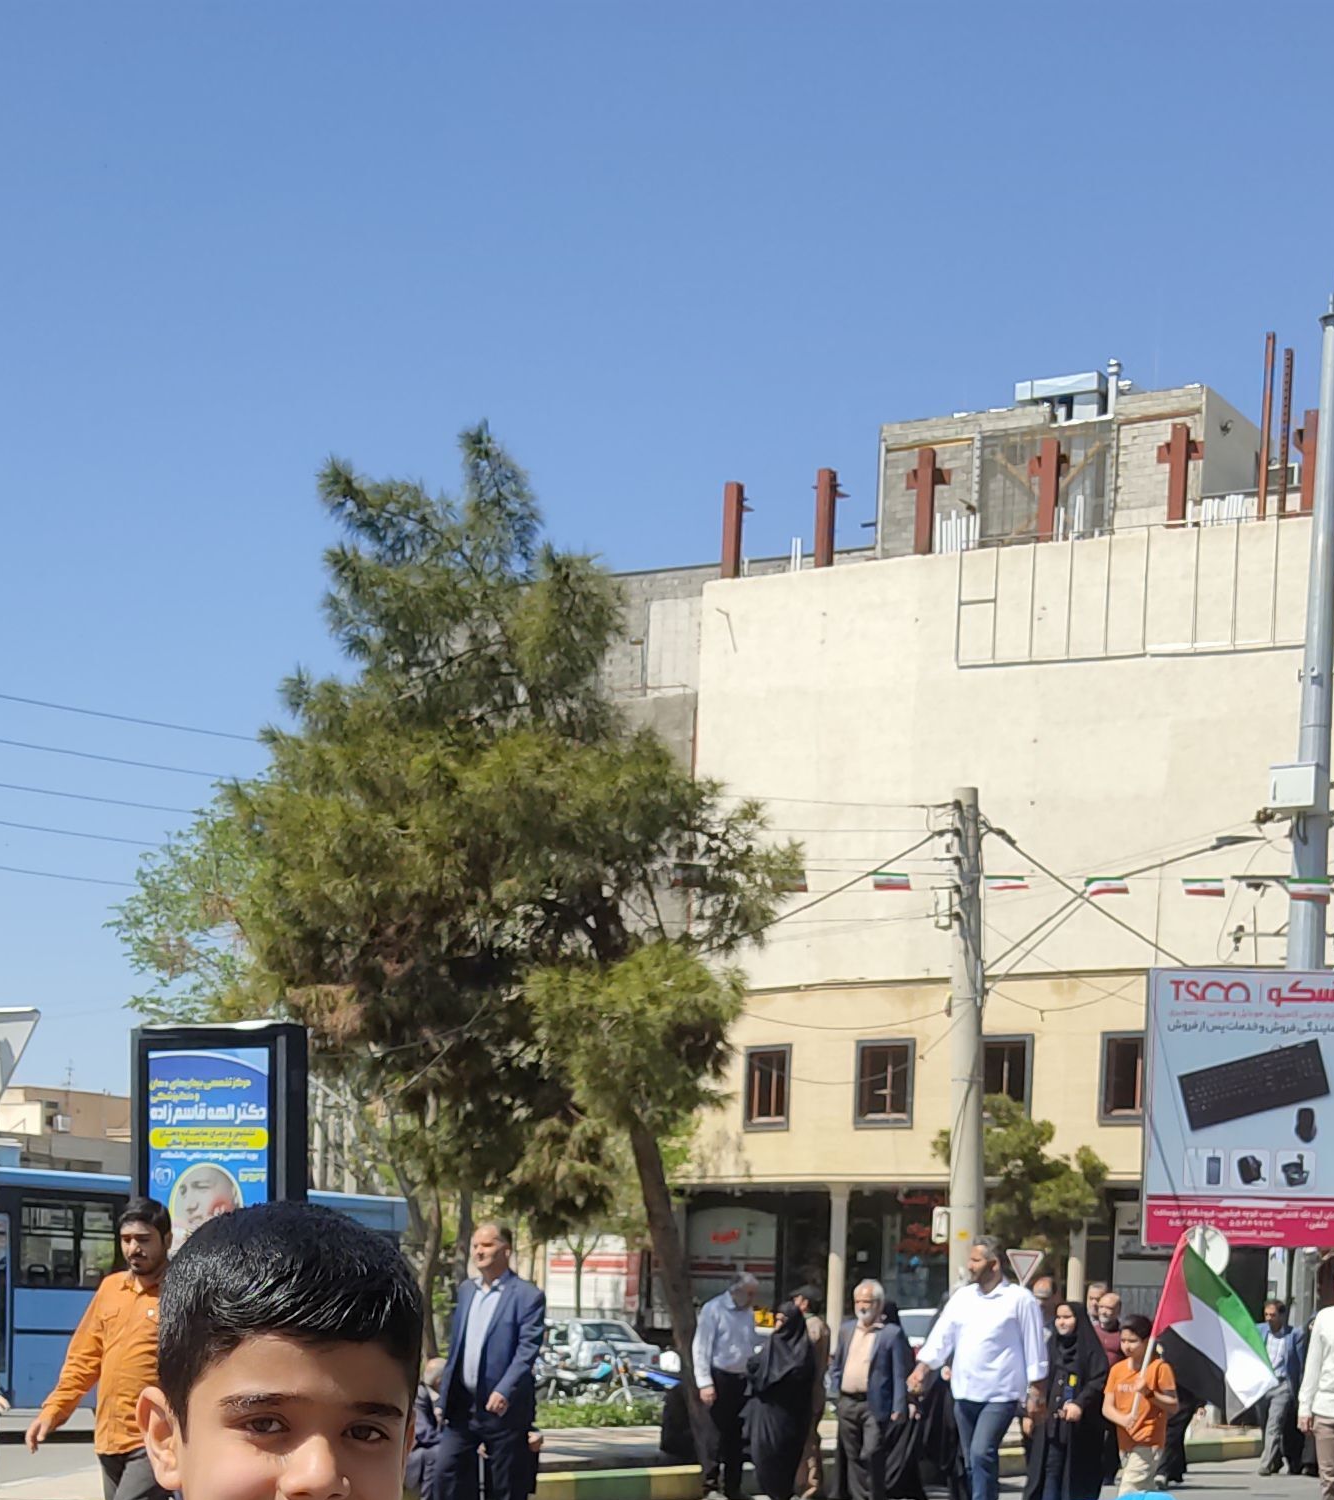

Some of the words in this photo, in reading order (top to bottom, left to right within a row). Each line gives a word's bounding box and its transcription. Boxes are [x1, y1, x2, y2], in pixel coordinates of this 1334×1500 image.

[1167, 1018, 1199, 1033] فروش
[1206, 1024, 1226, 1034] پس
[1226, 1020, 1259, 1031] خدمات
[1265, 1021, 1296, 1035] فروش
[149, 1102, 173, 1125] زاده
[172, 1102, 207, 1126] قاسم
[207, 1103, 235, 1121] الهه
[234, 1102, 267, 1125] دکتر
